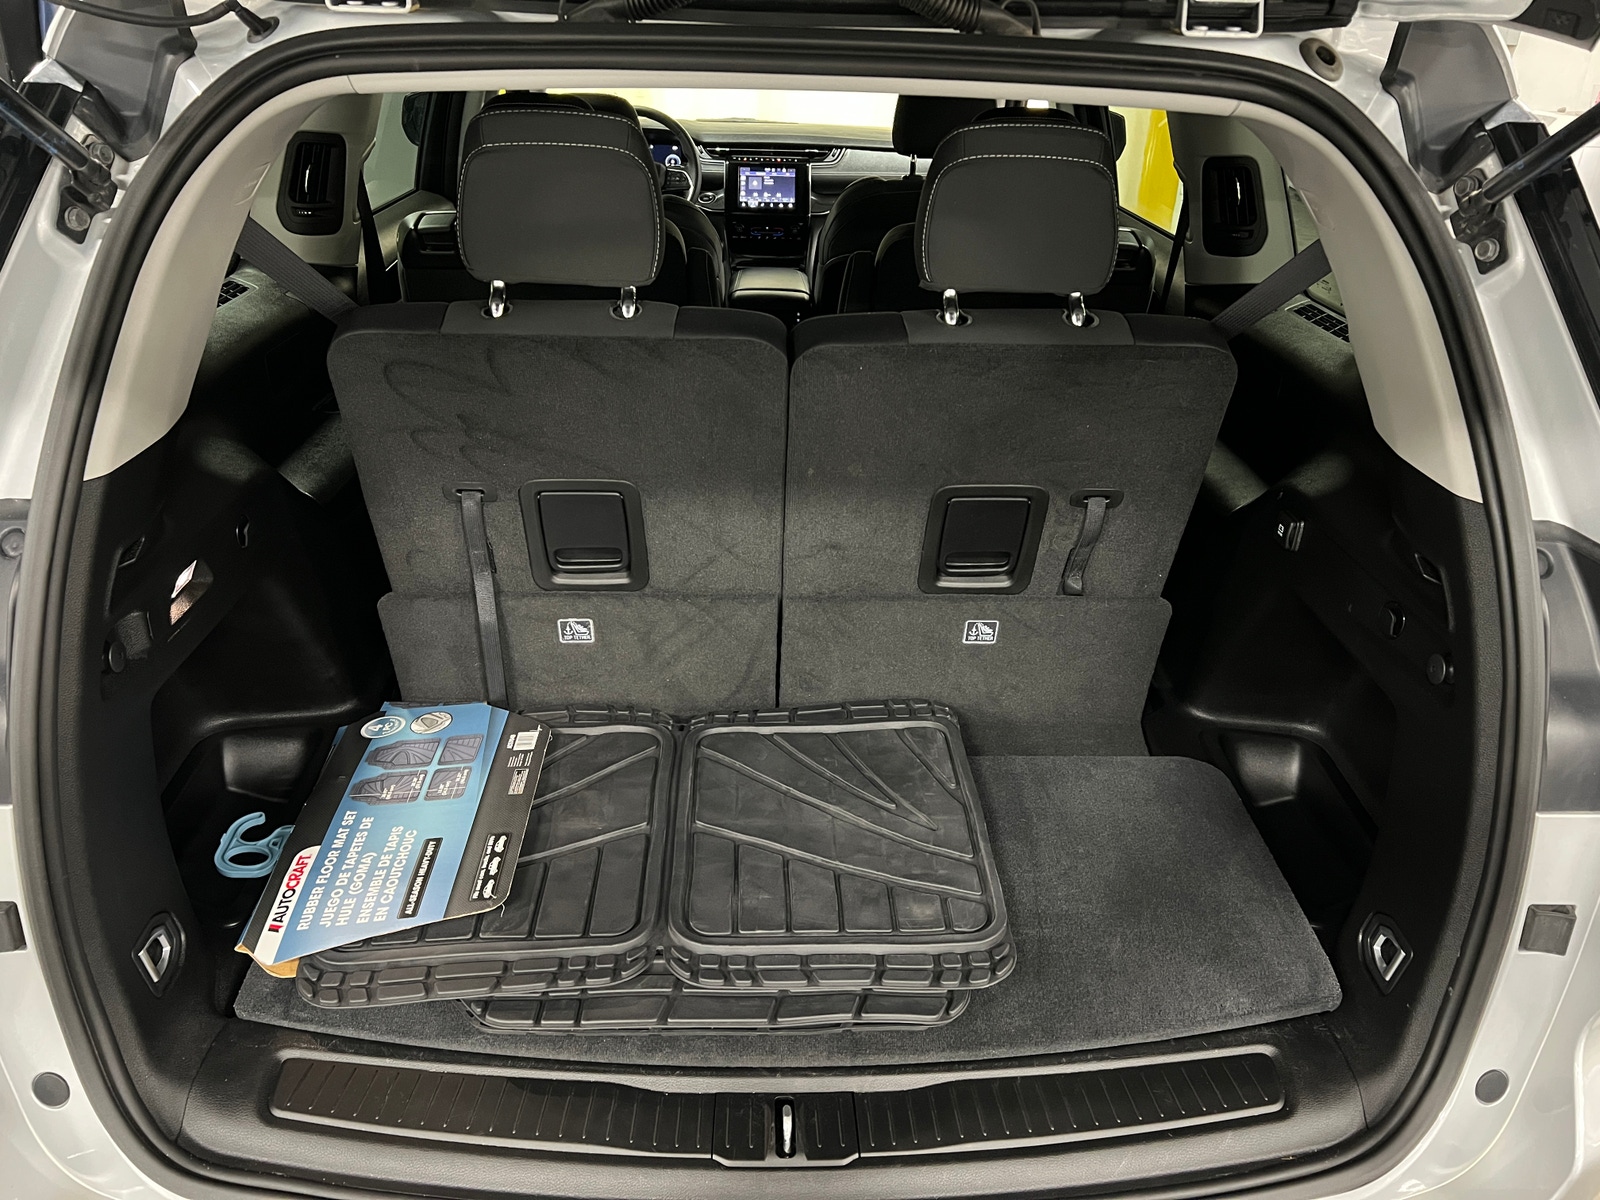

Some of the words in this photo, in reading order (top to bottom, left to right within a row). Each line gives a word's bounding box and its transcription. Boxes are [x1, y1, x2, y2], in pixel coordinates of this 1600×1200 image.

[360, 816, 374, 832] DE
[384, 826, 404, 854] TAPIS
[297, 886, 325, 931] RUBBER
[316, 851, 338, 884] FLOOR
[331, 828, 350, 849] MAT
[342, 810, 357, 826] SET
[342, 831, 368, 871] TAPETES
[378, 854, 392, 868] DE
[381, 829, 417, 904] CAOUTCHOUC
[272, 854, 311, 924] AUTOCRAFT
[335, 897, 356, 925] HULE
[349, 852, 378, 895] (GOMA)
[336, 872, 351, 886] DE
[356, 869, 385, 924] ENSEMBLE
[405, 875, 424, 915] ALL-SEASON
[417, 840, 436, 874] HEAVY-DUTY
[319, 889, 344, 927] JUEGO
[374, 907, 389, 922] EN
